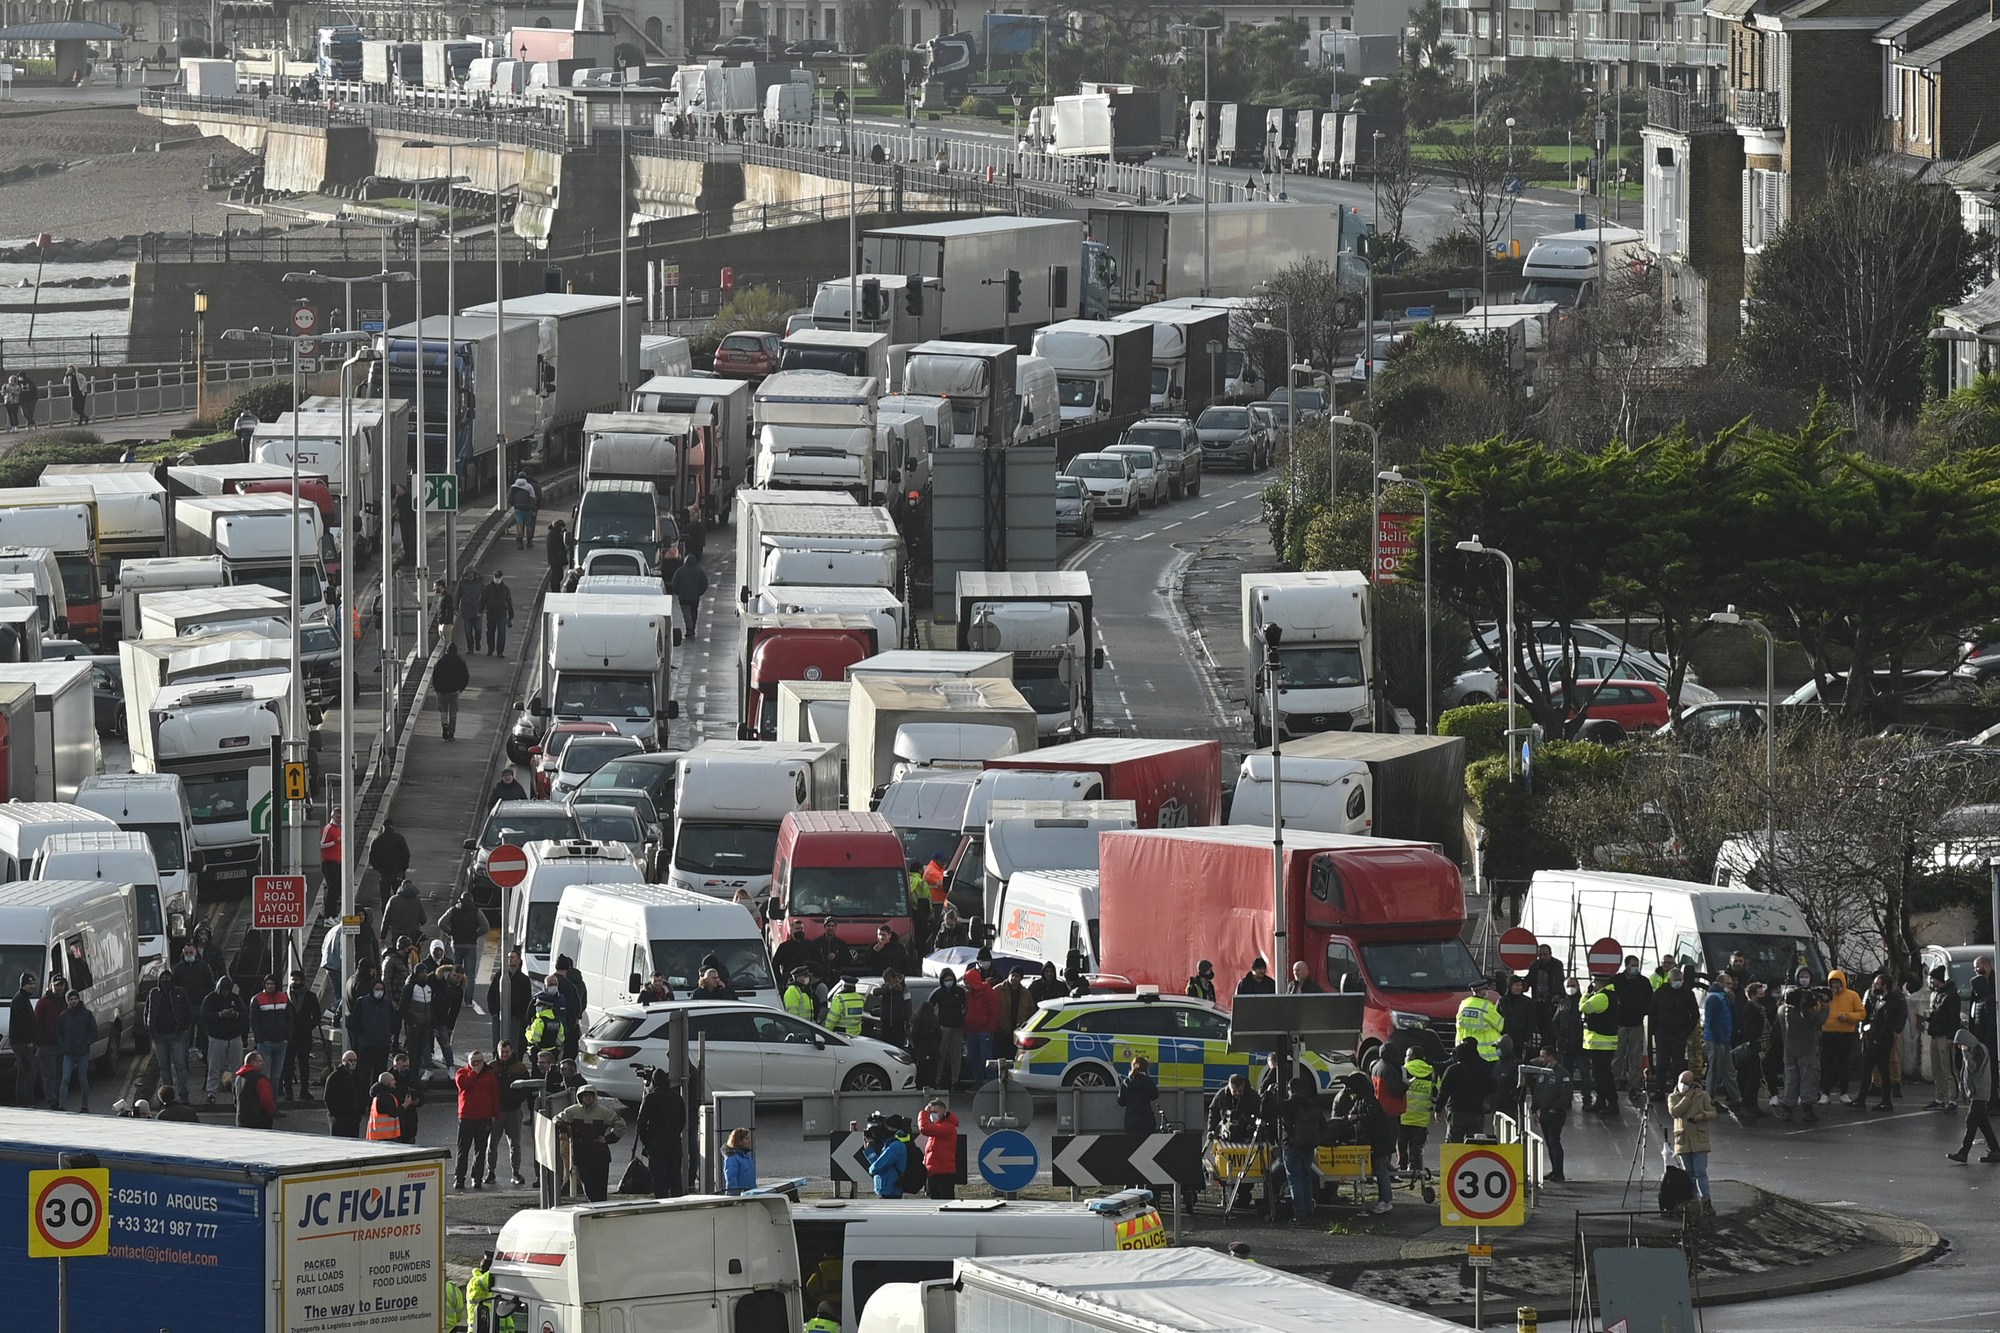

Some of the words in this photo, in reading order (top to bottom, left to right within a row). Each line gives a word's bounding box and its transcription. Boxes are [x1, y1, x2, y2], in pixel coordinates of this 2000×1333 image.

[1381, 521, 1399, 529] The
[266, 880, 293, 890] NEW
[263, 891, 295, 901] ROAD
[258, 902, 301, 913] LAYOUT
[1710, 903, 1746, 916] Animals
[1747, 903, 1766, 911] way
[259, 914, 299, 924] AHEAD
[406, 1170, 436, 1180] FRUEHAUF
[1457, 1170, 1508, 1199] 30
[166, 1193, 218, 1212] ARQUES
[297, 1192, 332, 1229] JC
[337, 1181, 427, 1224] FIOLET
[45, 1197, 93, 1228] 30
[117, 1215, 141, 1231] +33
[143, 1217, 165, 1234] 321
[169, 1220, 192, 1237] 987
[195, 1222, 218, 1239] 777
[351, 1223, 422, 1242] TRANSPORTS
[1121, 1230, 1166, 1251] POLICE
[106, 1244, 219, 1266] contact@jcfiolet.com
[389, 1249, 411, 1260] BULK
[304, 1258, 337, 1270] PACKED
[368, 1265, 391, 1276] FOOD
[392, 1260, 431, 1273] POWDERS
[296, 1274, 316, 1284] FULL
[317, 1270, 344, 1282] LOADS
[372, 1277, 395, 1288] FOOD
[396, 1273, 427, 1285] LIQUIDS
[296, 1286, 316, 1297] PART
[317, 1283, 344, 1294] LOADS
[304, 1304, 328, 1319] The
[331, 1302, 355, 1317] way
[359, 1300, 371, 1312] to
[375, 1295, 418, 1311] Europe
[291, 1325, 320, 1333] Transports
[326, 1320, 351, 1331] Logistics
[352, 1318, 369, 1327] under
[369, 1317, 380, 1325] ISO
[380, 1315, 398, 1324] 22000
[399, 1311, 432, 1322] certification
